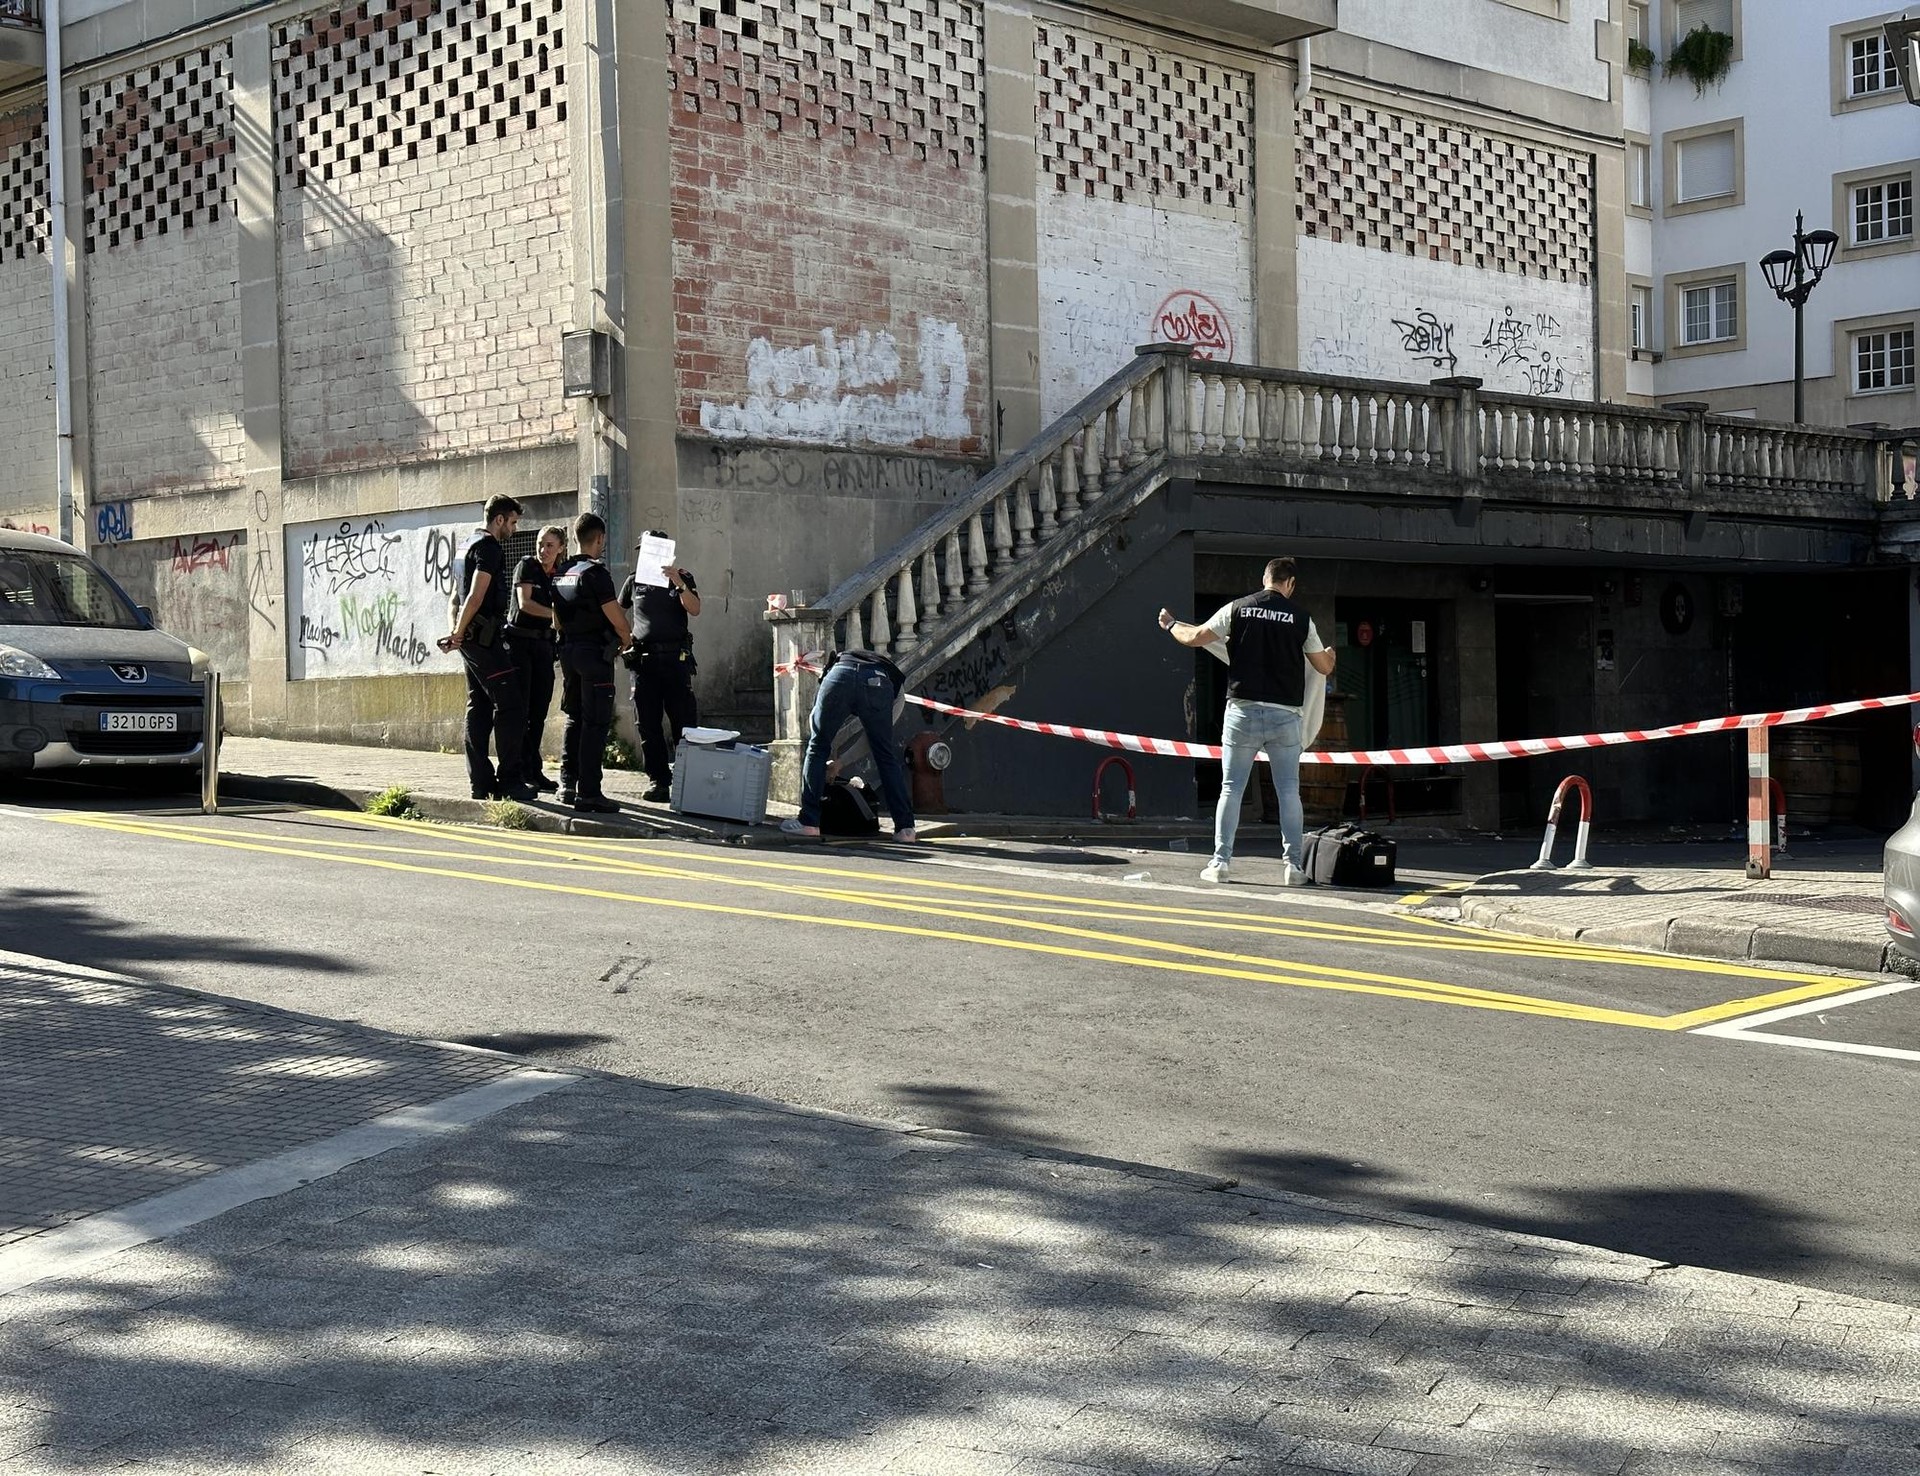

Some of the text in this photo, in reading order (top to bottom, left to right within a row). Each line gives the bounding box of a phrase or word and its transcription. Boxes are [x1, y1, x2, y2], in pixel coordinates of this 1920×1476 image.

[1241, 607, 1294, 624] ERTZAINTZA
[112, 715, 174, 730] 3210 GPS
